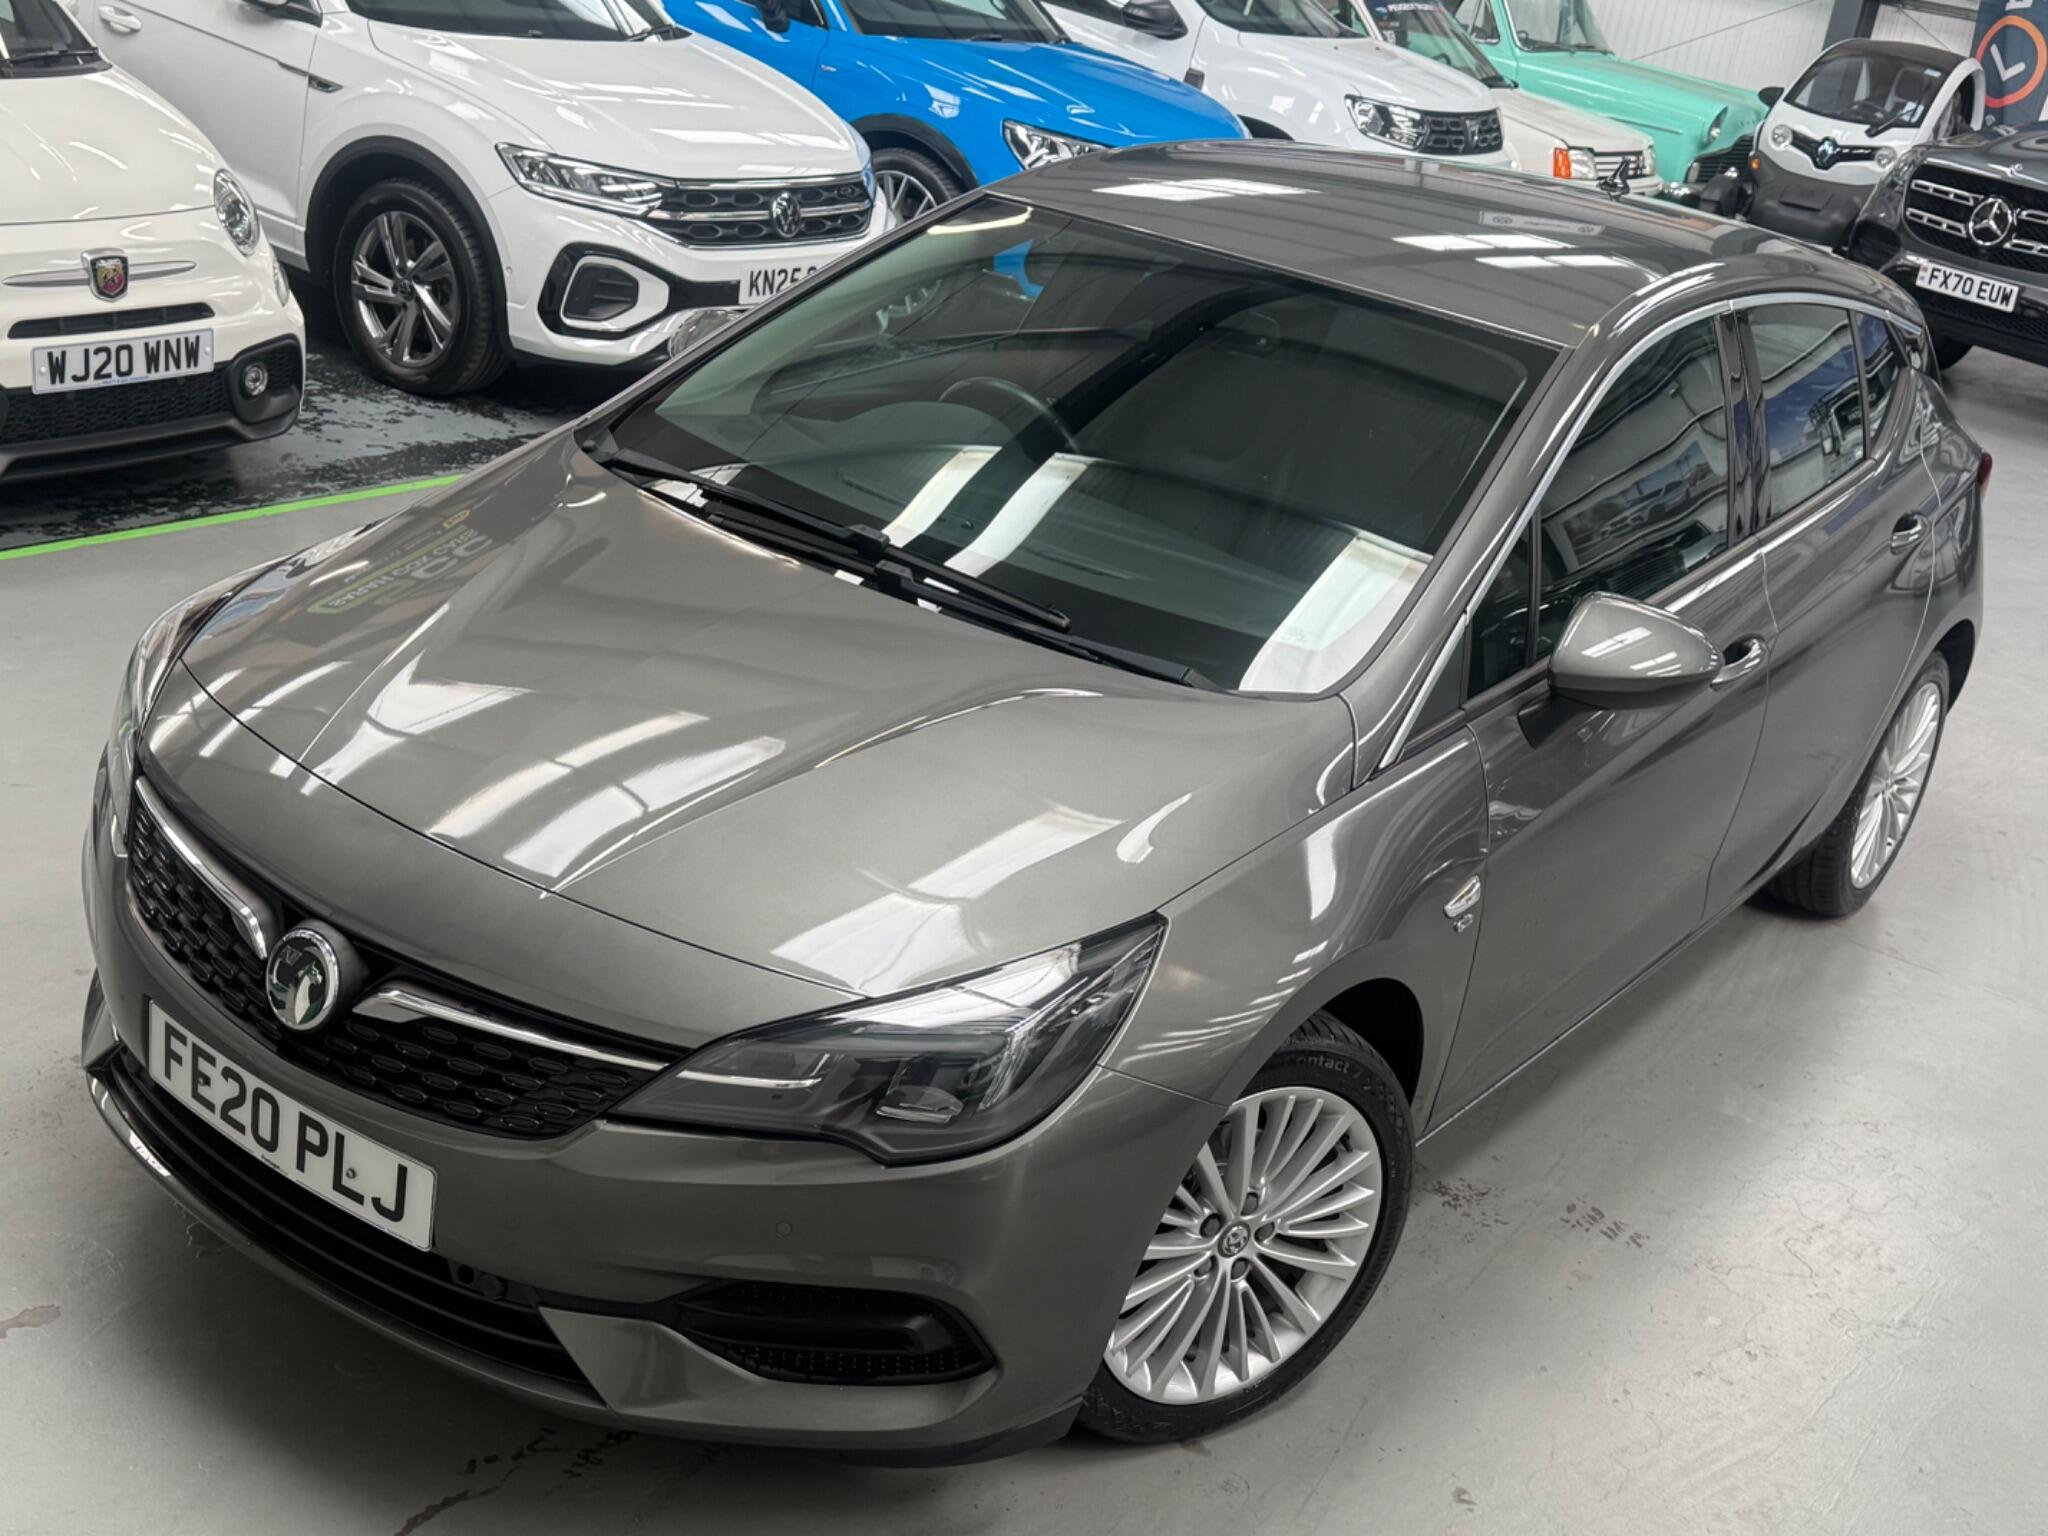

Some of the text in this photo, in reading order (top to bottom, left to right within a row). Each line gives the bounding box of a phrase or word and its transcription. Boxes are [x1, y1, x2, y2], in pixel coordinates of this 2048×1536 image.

[1927, 267, 2013, 307] FX70 EUW
[47, 335, 200, 385] WJ20 WNW
[164, 1020, 408, 1223] FE20 PLJ
